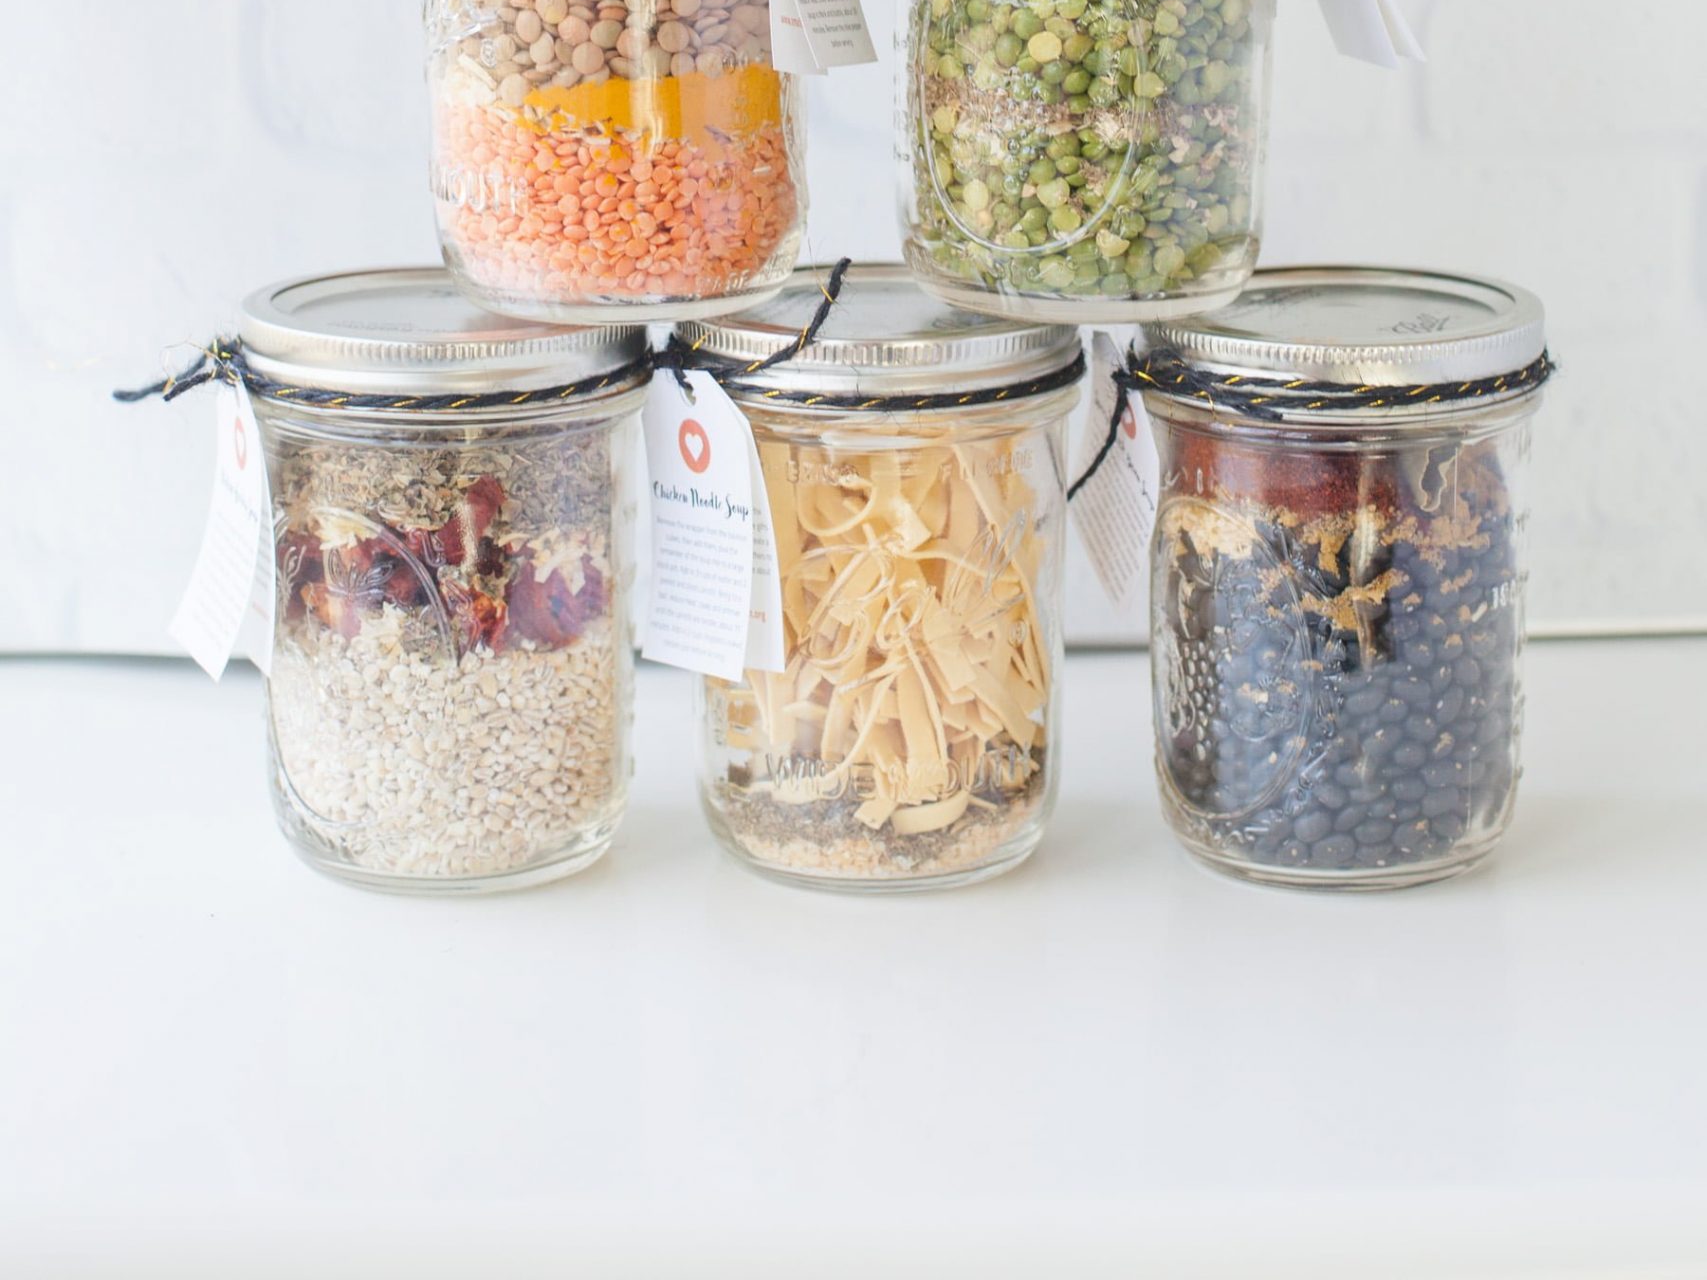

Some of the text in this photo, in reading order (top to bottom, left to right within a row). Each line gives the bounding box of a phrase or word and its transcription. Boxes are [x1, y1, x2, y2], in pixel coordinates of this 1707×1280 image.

[653, 480, 749, 522] Chicken Noodle Soup
